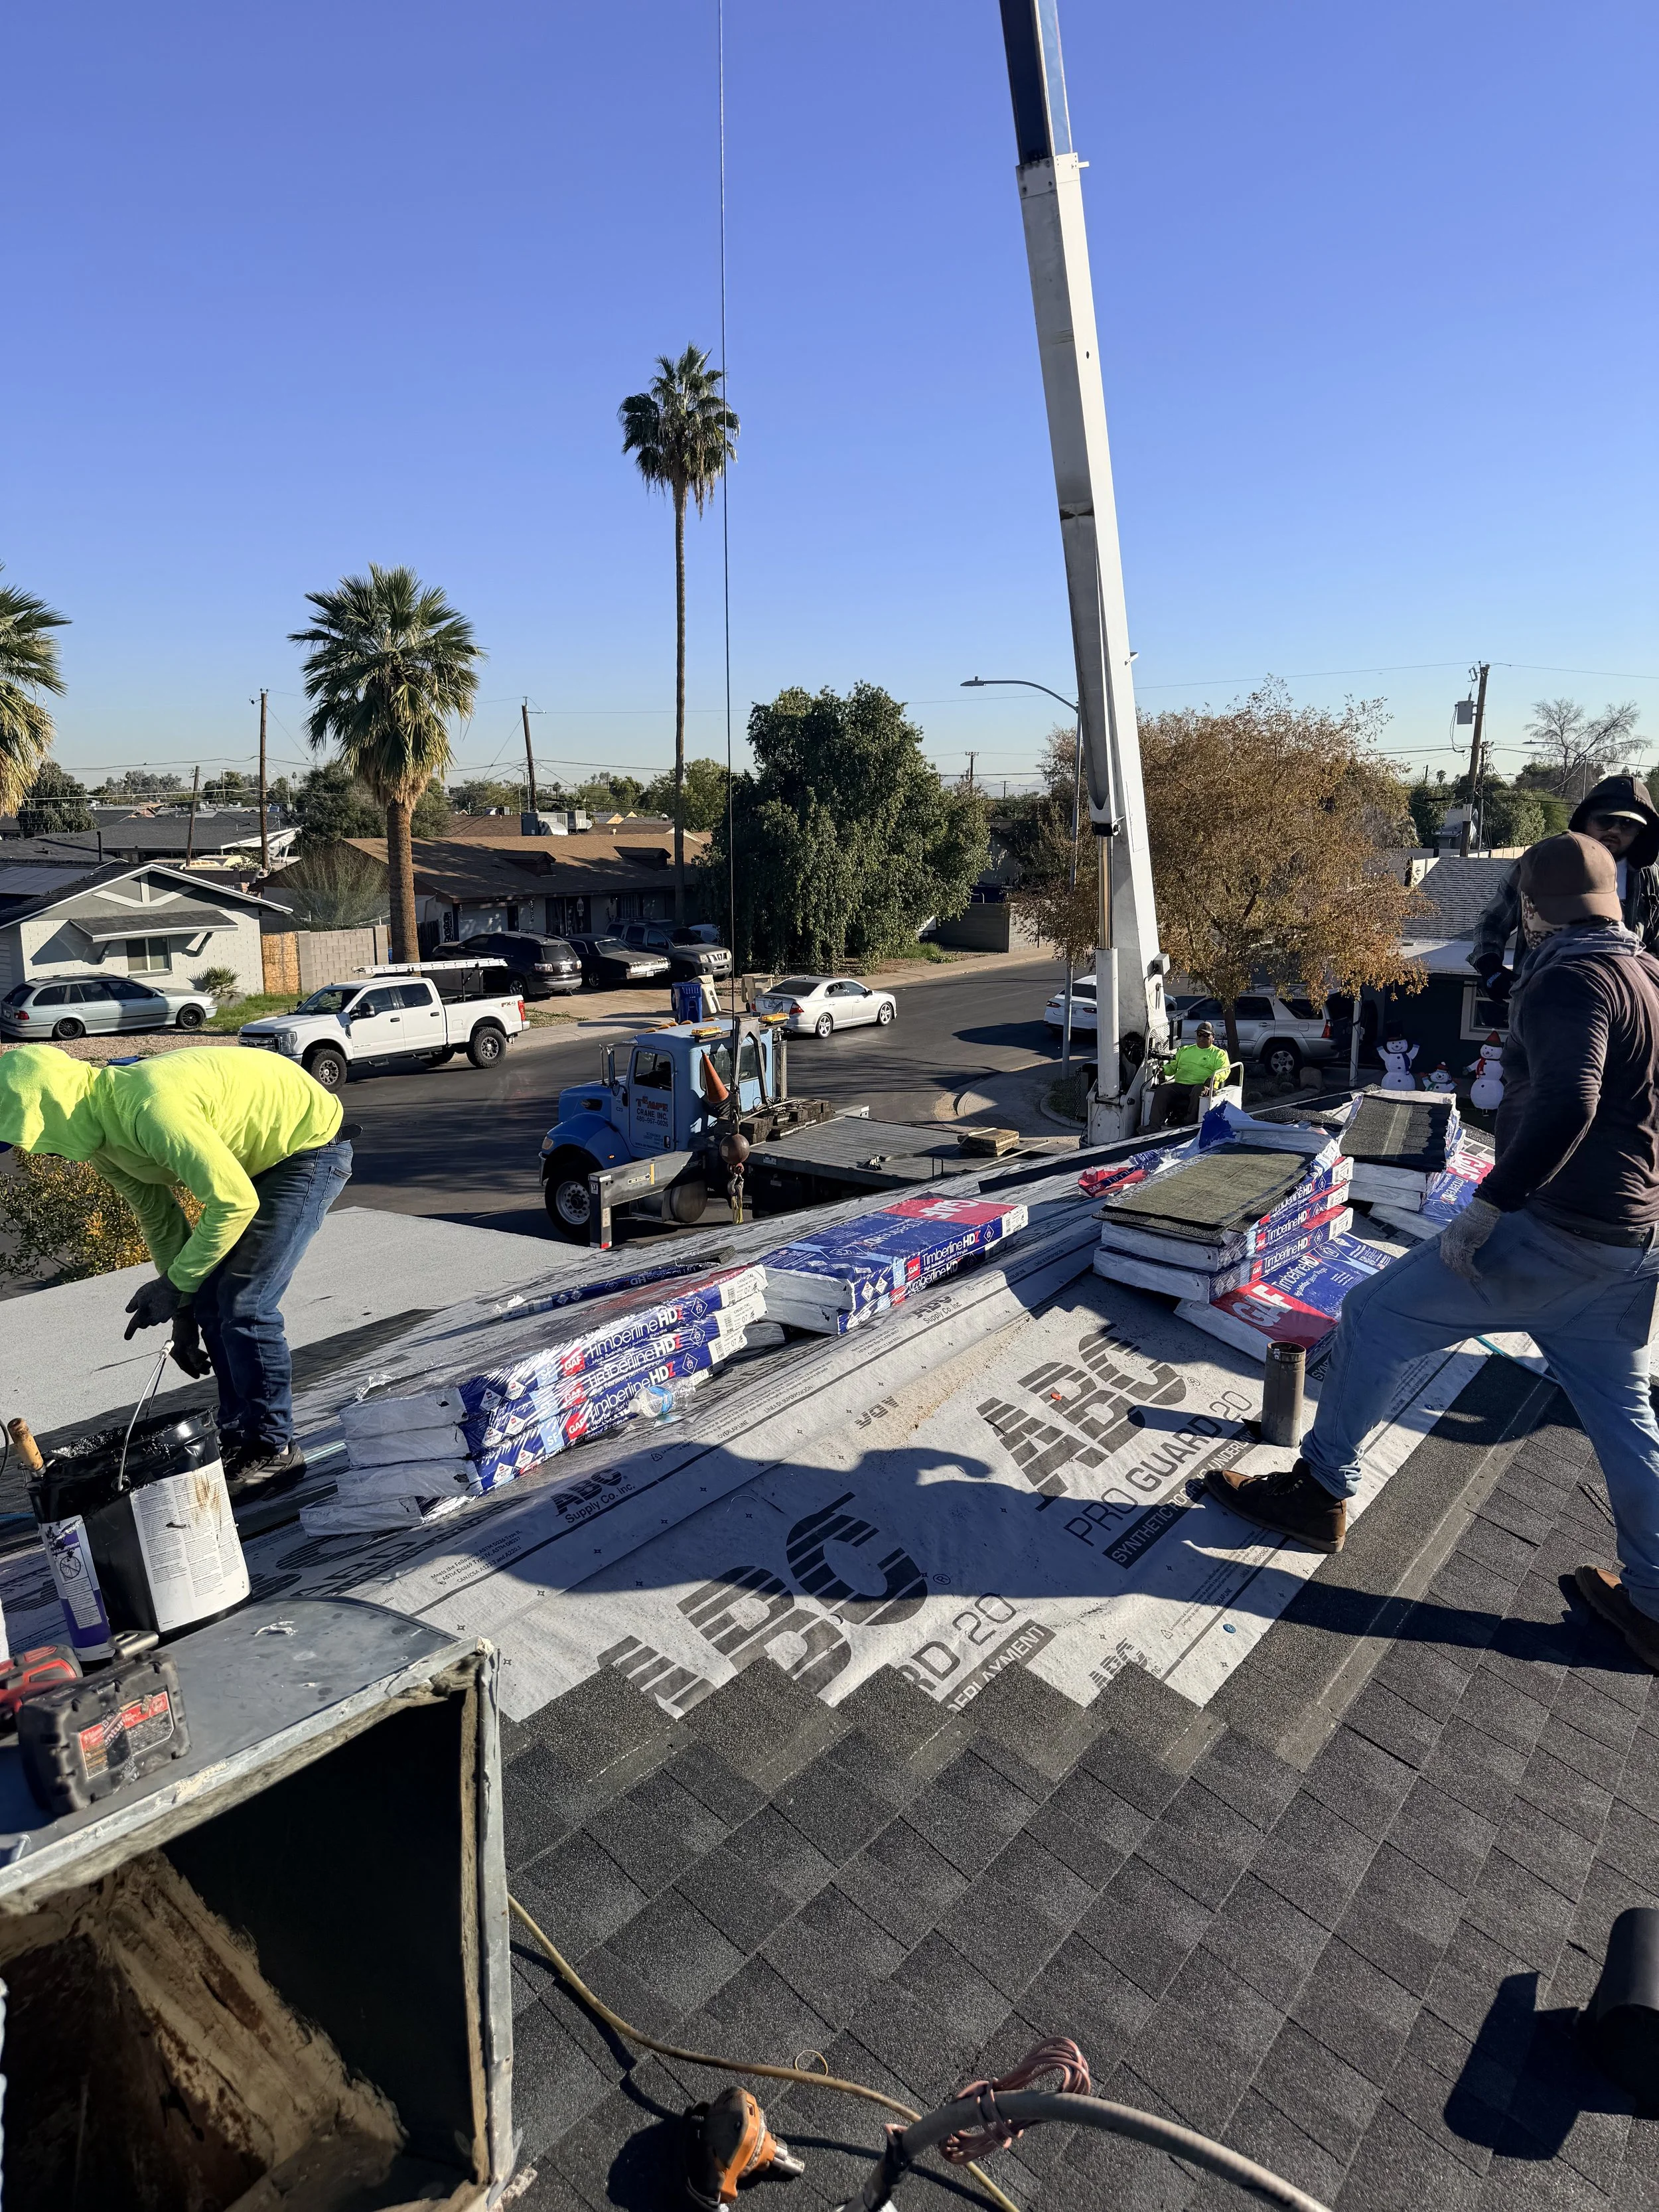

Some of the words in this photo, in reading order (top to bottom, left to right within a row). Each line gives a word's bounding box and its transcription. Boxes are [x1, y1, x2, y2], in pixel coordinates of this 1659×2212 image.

[637, 1108, 655, 1118] CRANE
[918, 1199, 979, 1219] GAF
[907, 1264, 921, 1274] GAF
[922, 1242, 962, 1266] Timberline
[962, 1230, 979, 1249] HDZ
[923, 1310, 944, 1325] Supply
[1232, 1284, 1294, 1327] GAF
[545, 1432, 562, 1447] SF
[647, 1361, 676, 1384] HDZ
[975, 1323, 1187, 1512] ABC
[717, 1424, 739, 1439] OVERLAP
[737, 1419, 749, 1428] LINE
[1064, 1487, 1139, 1547] PRO
[1125, 1416, 1223, 1492] GUARD
[1209, 1391, 1252, 1424] 20
[550, 1468, 622, 1517] ABC
[563, 1499, 601, 1525] Supply
[599, 1489, 619, 1505] Co.
[1112, 1505, 1173, 1563] SYNTHETIC
[1210, 1429, 1256, 1471] UNDERLAY
[952, 1592, 1017, 1646] 20
